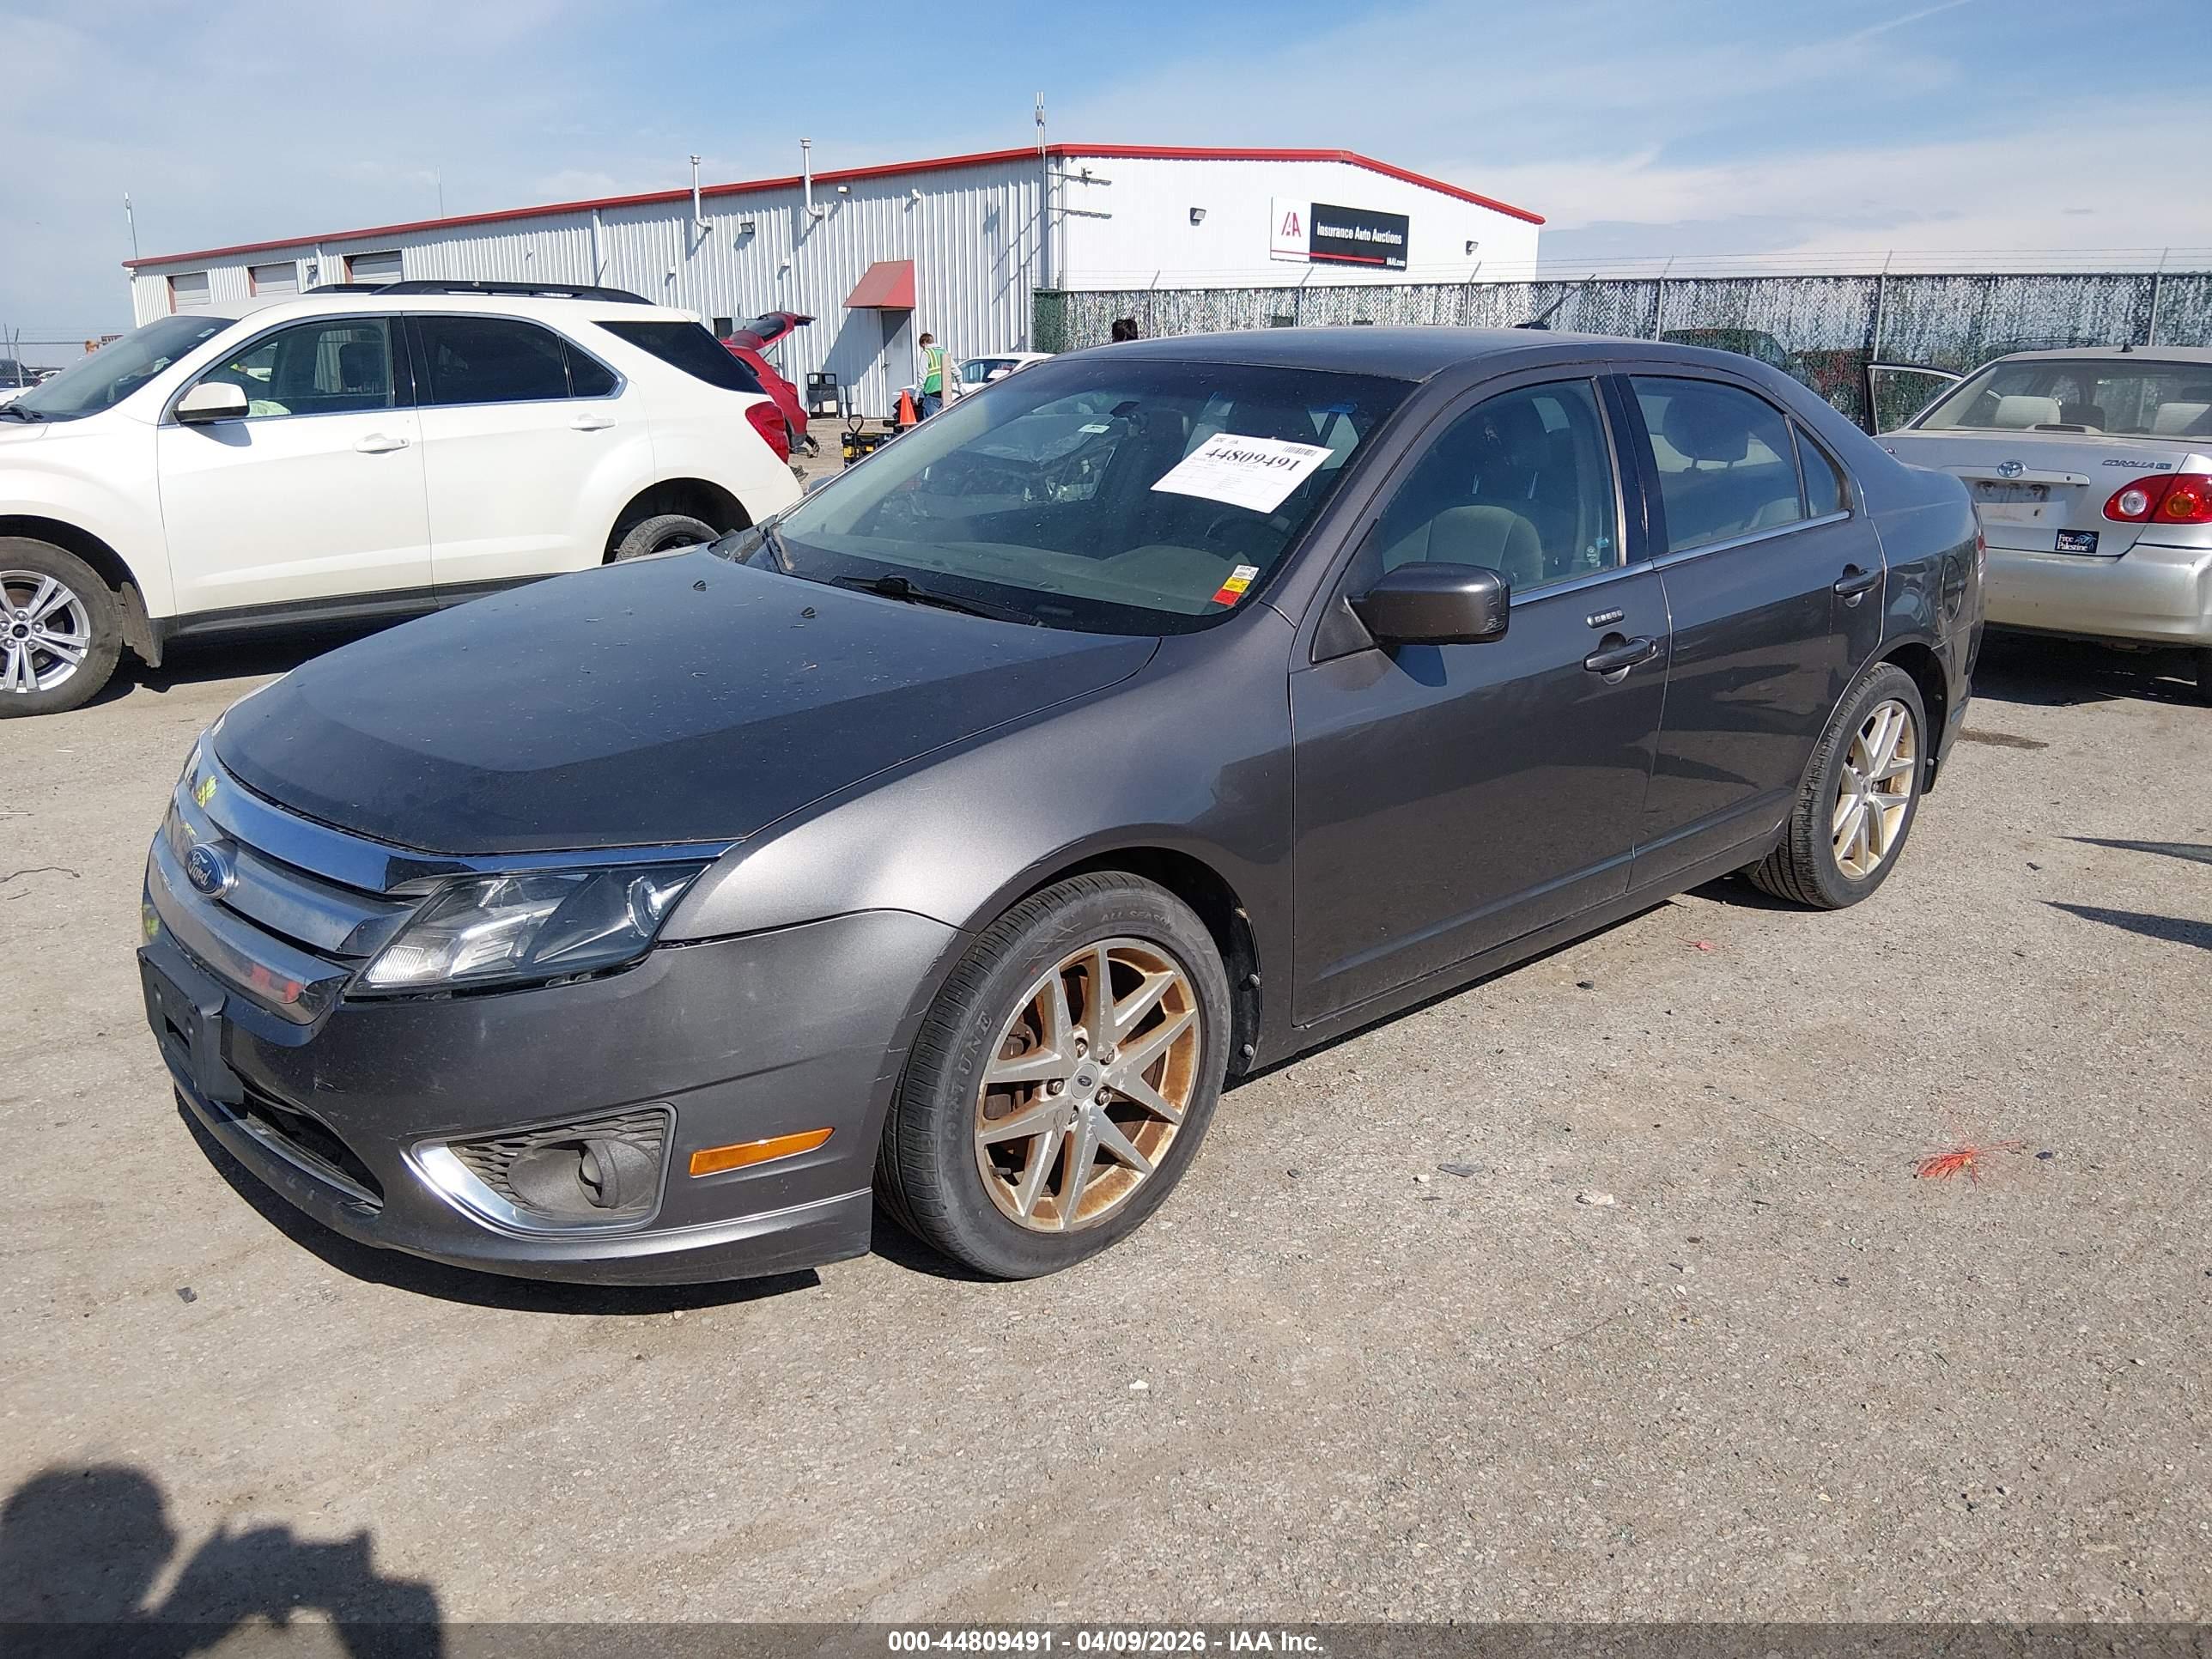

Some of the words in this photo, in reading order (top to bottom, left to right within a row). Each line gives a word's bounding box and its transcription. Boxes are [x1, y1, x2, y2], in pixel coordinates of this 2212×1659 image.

[1317, 222, 1353, 239] Insurance
[1355, 226, 1370, 240] Auto
[1372, 228, 1401, 244] Auctions
[1206, 447, 1301, 471] 44809491
[2102, 459, 2154, 468] COROLLA
[2057, 541, 2088, 551] Palestine
[2058, 533, 2074, 543] Free
[187, 851, 212, 885] Ford
